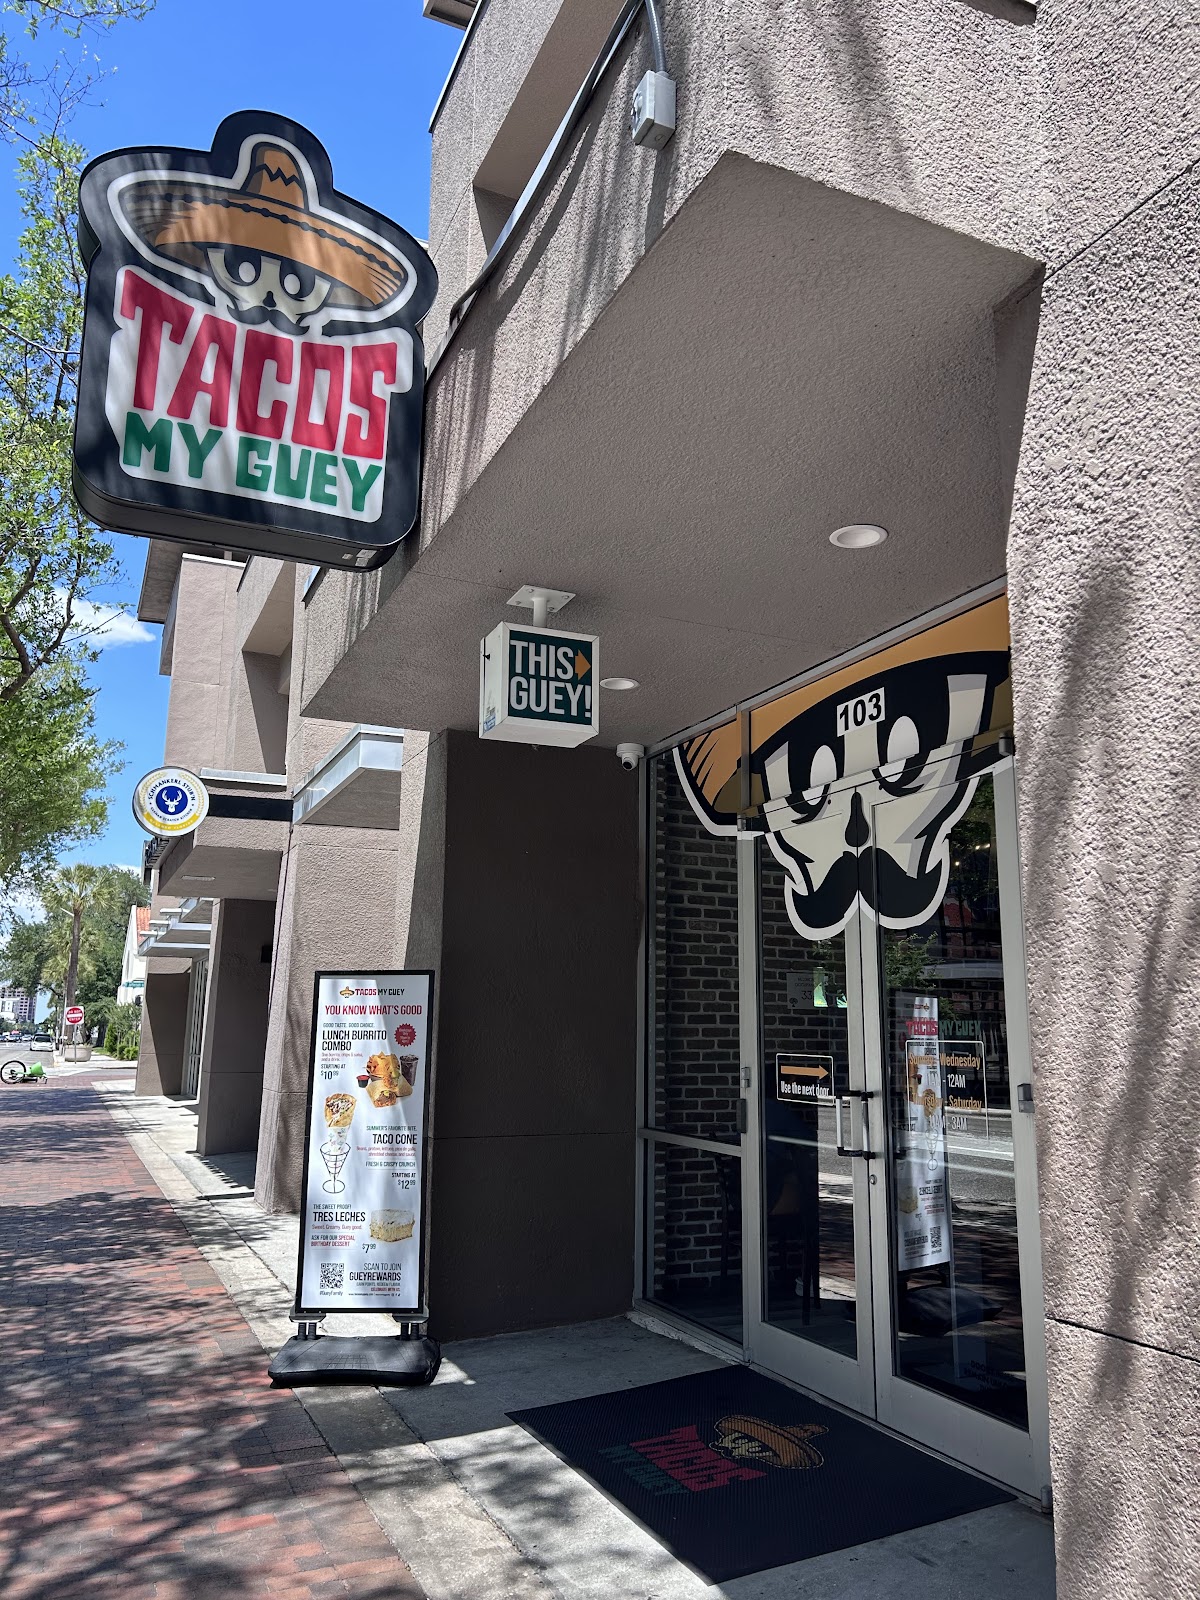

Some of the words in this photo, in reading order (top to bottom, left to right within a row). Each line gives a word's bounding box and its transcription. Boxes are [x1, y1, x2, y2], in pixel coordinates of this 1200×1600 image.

[120, 269, 398, 459] TACOS
[123, 412, 223, 478] MY
[236, 436, 383, 512] GUEY
[510, 640, 574, 680] THIS
[510, 676, 592, 718] GUEY!
[840, 693, 882, 731] 103
[355, 988, 377, 996] TACOS
[378, 988, 388, 996] MY
[388, 988, 405, 996] GUEY
[325, 1005, 341, 1015] YOU
[342, 1005, 367, 1015] KNOW
[368, 1005, 399, 1015] WHAT'S
[400, 1005, 422, 1015] GOOD
[322, 1030, 350, 1040] LUNCH
[351, 1030, 387, 1040] BURRITO
[906, 1021, 938, 1036] TACOS
[940, 1021, 955, 1036] MY
[321, 1041, 352, 1051] COMBO
[940, 1053, 981, 1070] Wednesday
[947, 1073, 966, 1089] 12AM
[781, 1081, 791, 1093] Use
[791, 1082, 801, 1094] the
[801, 1084, 815, 1096] next
[815, 1084, 829, 1097] door
[949, 1095, 982, 1112] Saturday
[952, 1116, 968, 1131] 3AM
[372, 1133, 394, 1145] TACO
[395, 1133, 418, 1145] CONE
[313, 1211, 334, 1222] TRES
[335, 1211, 366, 1222] LECHES
[363, 1262, 380, 1271] SCAN
[381, 1262, 389, 1271] TO
[389, 1262, 402, 1271] JOIN
[349, 1271, 402, 1281] GUEYREWARDS
[629, 1425, 768, 1492] TACOS
